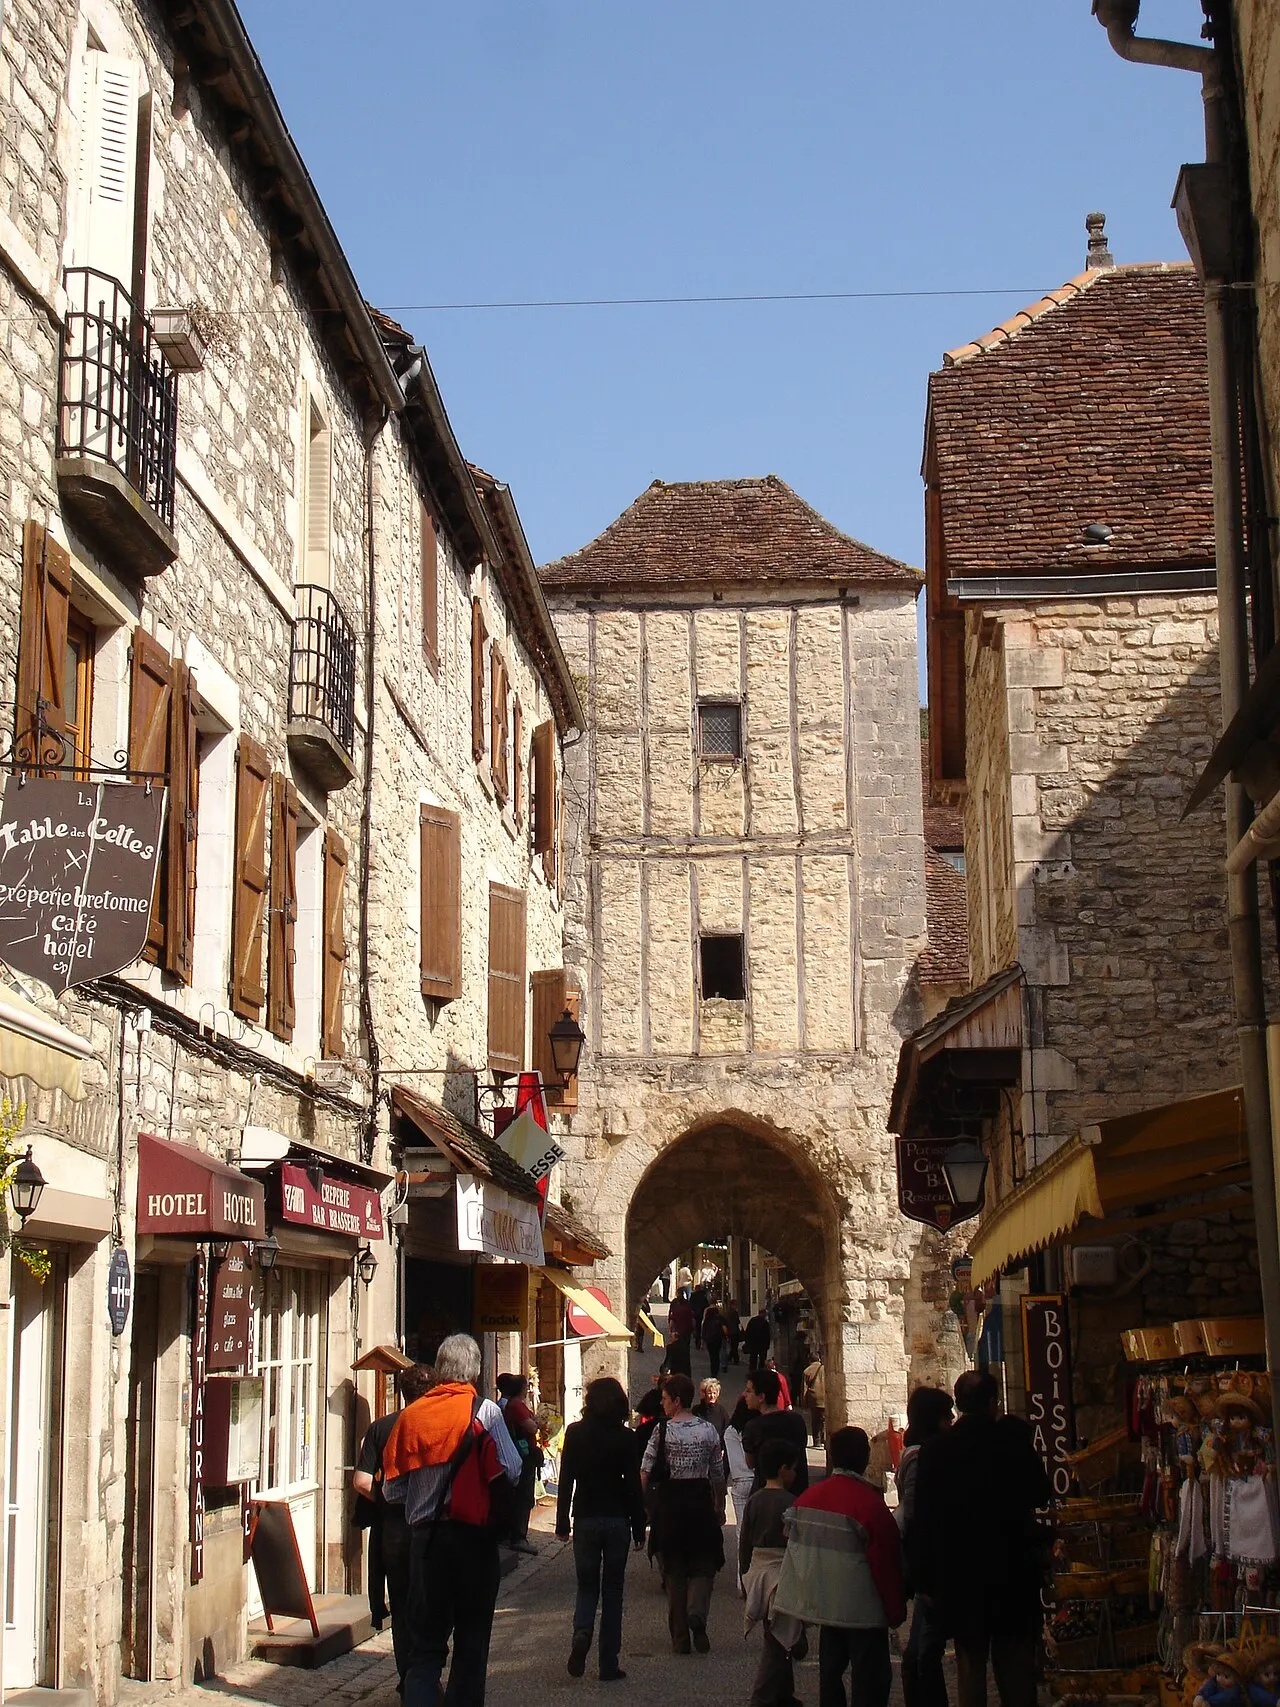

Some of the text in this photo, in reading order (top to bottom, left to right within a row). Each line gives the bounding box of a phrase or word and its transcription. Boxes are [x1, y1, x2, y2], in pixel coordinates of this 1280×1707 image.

[77, 791, 93, 807] La
[0, 816, 154, 860] Table des Celtes
[73, 885, 149, 913] bretonne
[51, 913, 98, 934] café
[43, 933, 94, 959] hôtel
[527, 1144, 564, 1181] ESSE
[148, 1194, 207, 1217] HOTEL
[223, 1192, 257, 1226] HOTEL
[321, 1183, 351, 1209] CREPERIE
[312, 1204, 326, 1226] BAR
[329, 1208, 361, 1234] BRASSERIE
[480, 1315, 521, 1326] Kodak
